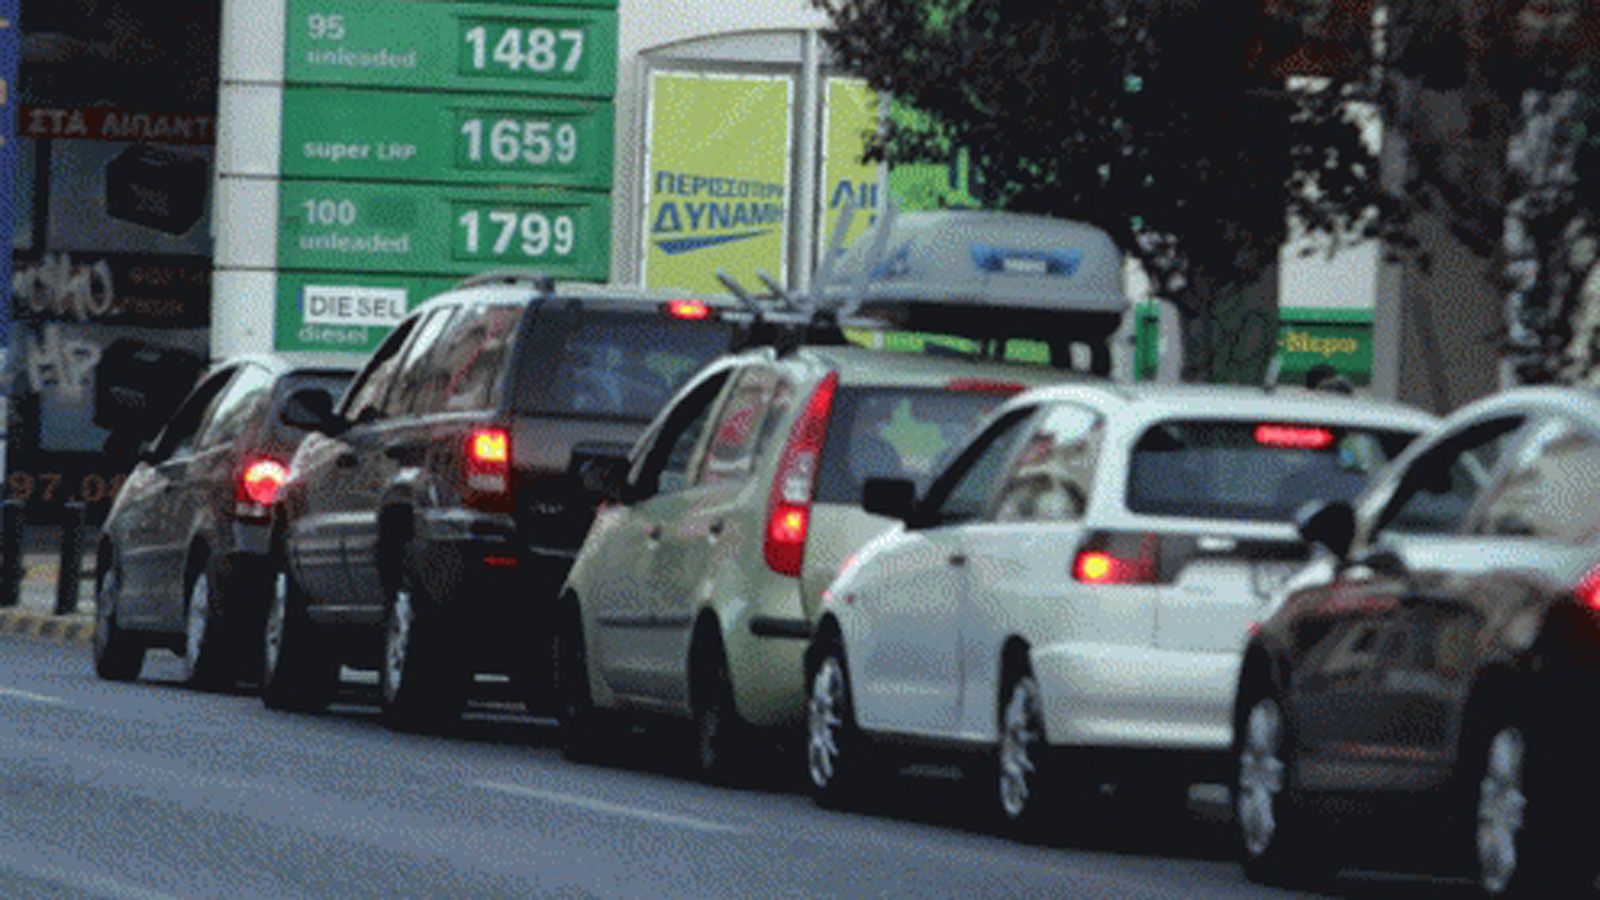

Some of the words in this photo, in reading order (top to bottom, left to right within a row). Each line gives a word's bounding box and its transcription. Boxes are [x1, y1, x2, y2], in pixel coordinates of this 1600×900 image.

[307, 13, 346, 40] 95
[305, 47, 418, 68] unleaded
[464, 26, 584, 73] 1487
[302, 141, 371, 162] super
[460, 118, 577, 164] 1659
[303, 198, 357, 226] 100
[298, 232, 411, 254] unleaded
[458, 209, 575, 256] 1799
[309, 295, 404, 319] DIESEL
[298, 325, 369, 345] diesel
